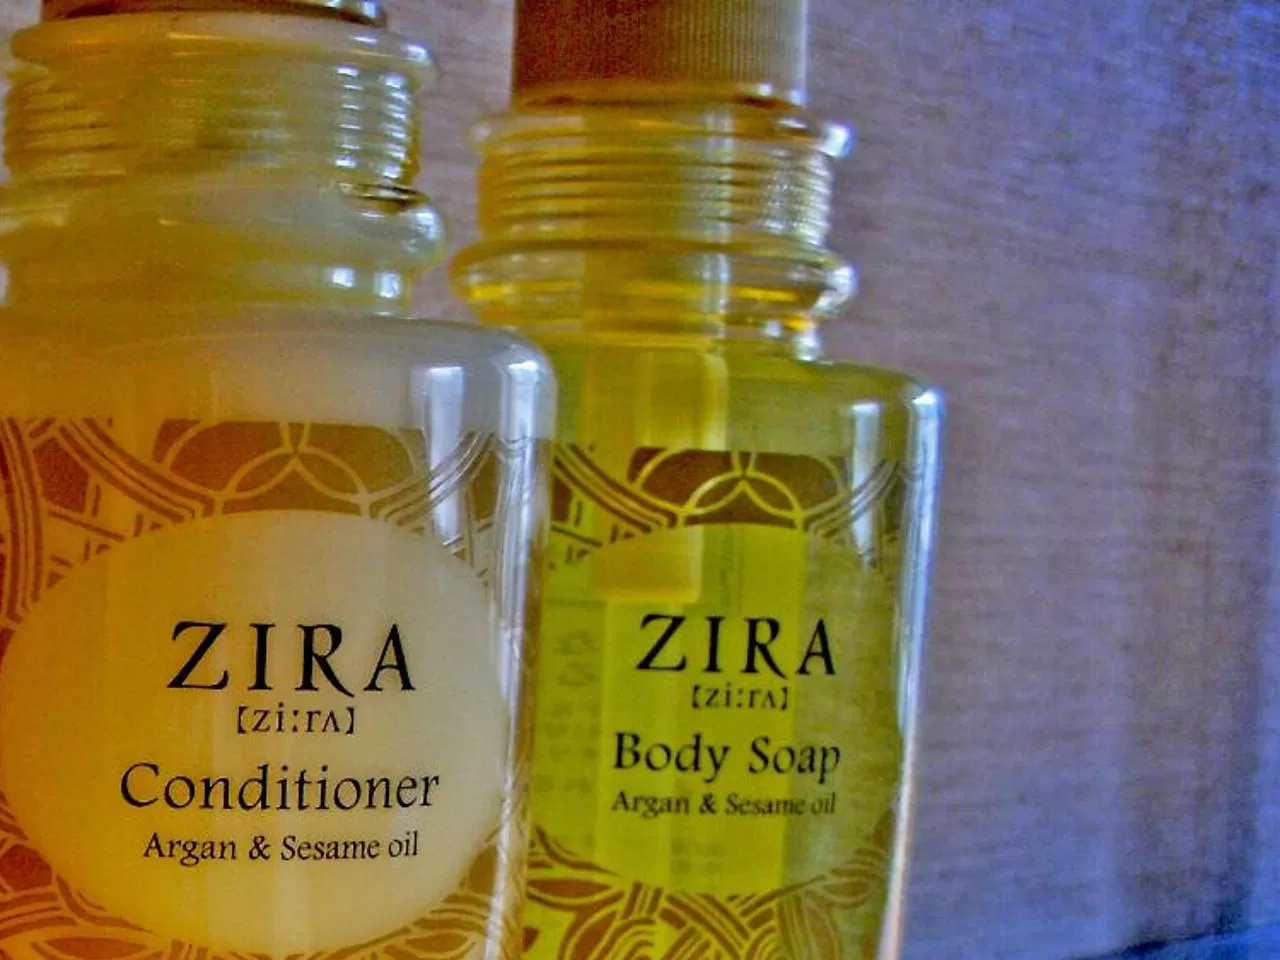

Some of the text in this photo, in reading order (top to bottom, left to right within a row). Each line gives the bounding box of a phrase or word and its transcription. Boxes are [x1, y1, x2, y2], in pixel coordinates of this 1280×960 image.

[167, 621, 417, 697] ZIRA
[635, 613, 836, 679] ZIRA
[612, 731, 841, 785] Body Soap
[120, 761, 440, 811] Conditioner
[611, 790, 836, 820] Argan & Sesame oil
[143, 830, 418, 867] Argan & Sesame oil
